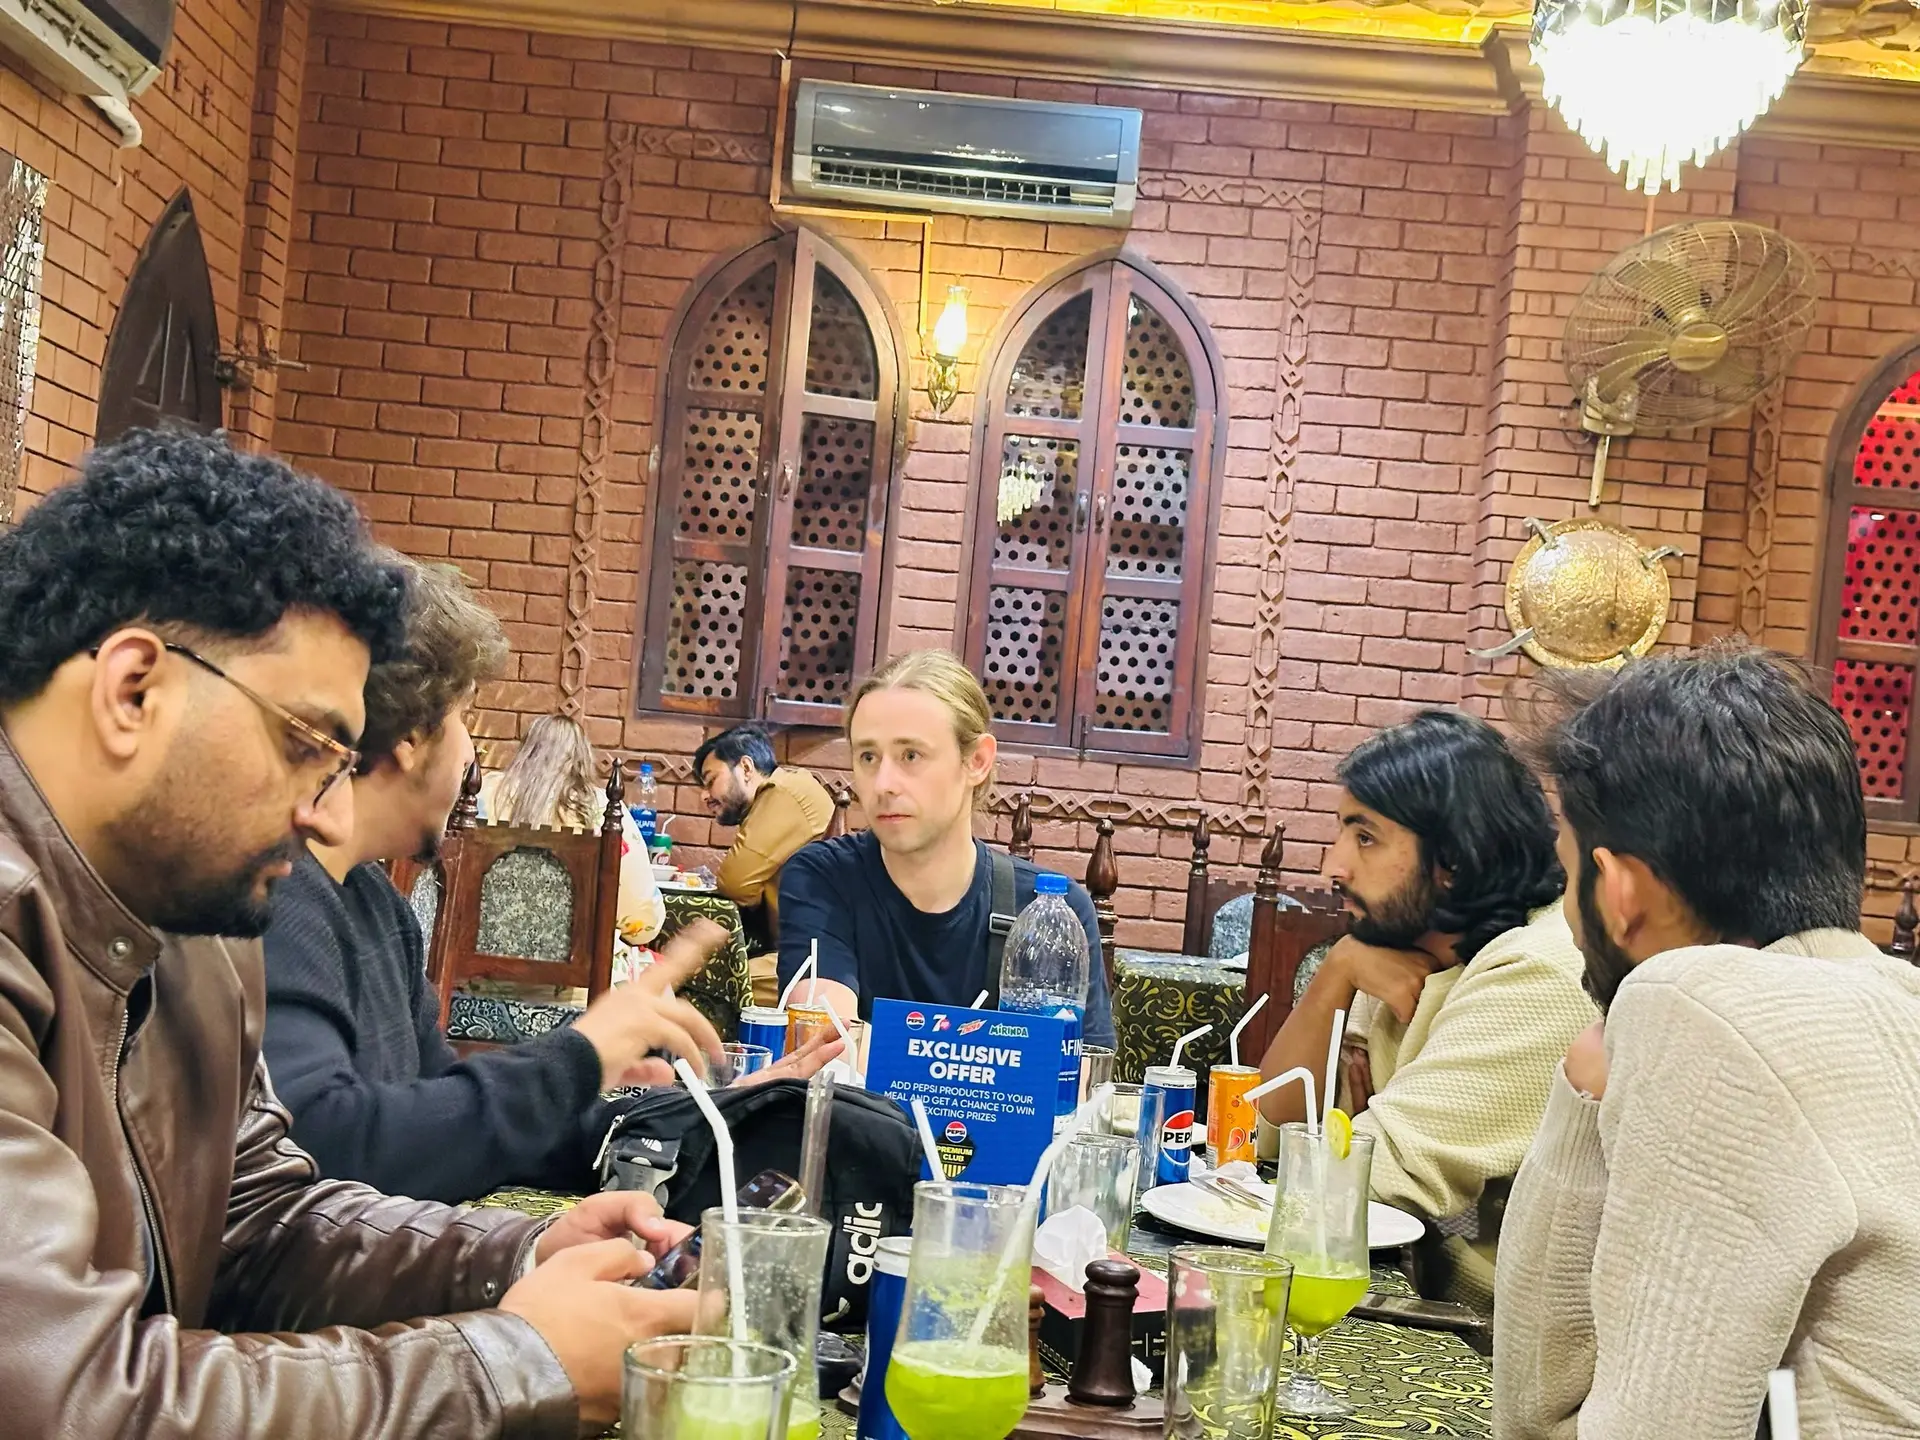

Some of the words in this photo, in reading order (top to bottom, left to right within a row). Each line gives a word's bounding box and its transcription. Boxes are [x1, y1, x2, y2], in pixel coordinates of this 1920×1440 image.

[908, 1038, 1022, 1068] EXCLUSIVE
[1061, 1038, 1082, 1056] AFIN
[929, 1061, 996, 1085] OFFER
[890, 1080, 912, 1091] ADD
[913, 1083, 938, 1094] PEPSI
[940, 1086, 990, 1100] PRODUCTS
[992, 1091, 1005, 1101] TO
[1007, 1093, 1034, 1105] YOUR
[884, 1091, 908, 1101] MEAL
[931, 1096, 950, 1106] GET
[951, 1098, 959, 1107] A
[960, 1099, 999, 1112] CHANCE
[1001, 1104, 1014, 1113] TO
[1015, 1105, 1036, 1116] WIN
[924, 1106, 965, 1119] EXCITING
[966, 1111, 997, 1123] PRIZES
[946, 1128, 966, 1136] PEPSI
[1163, 1131, 1192, 1144] PEP
[936, 1145, 973, 1156] PREMIUM
[942, 1153, 965, 1162] CLUB
